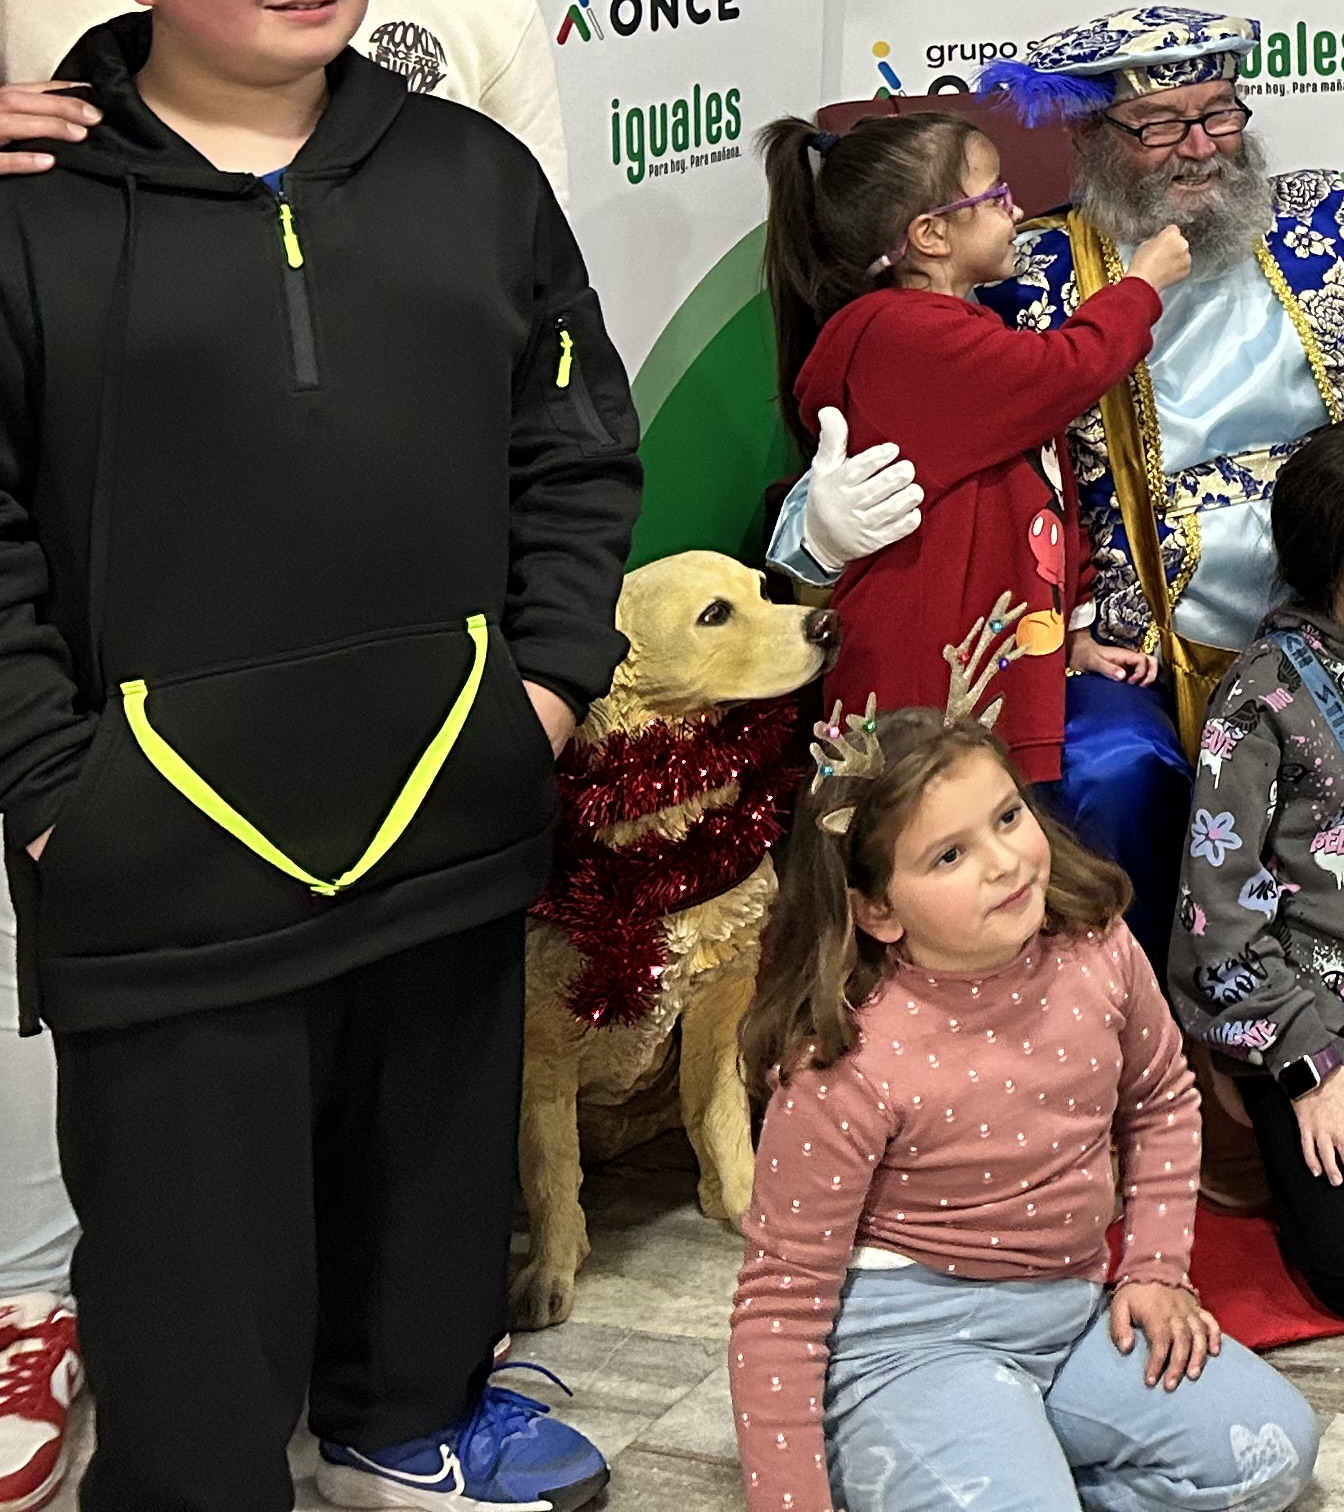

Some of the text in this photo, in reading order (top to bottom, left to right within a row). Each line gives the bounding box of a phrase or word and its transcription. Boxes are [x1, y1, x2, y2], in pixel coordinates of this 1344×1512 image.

[926, 42, 1017, 68] grupo
[1292, 81, 1317, 94] Para
[611, 83, 742, 186] iguales
[648, 161, 669, 179] Para
[690, 152, 710, 168] Para
